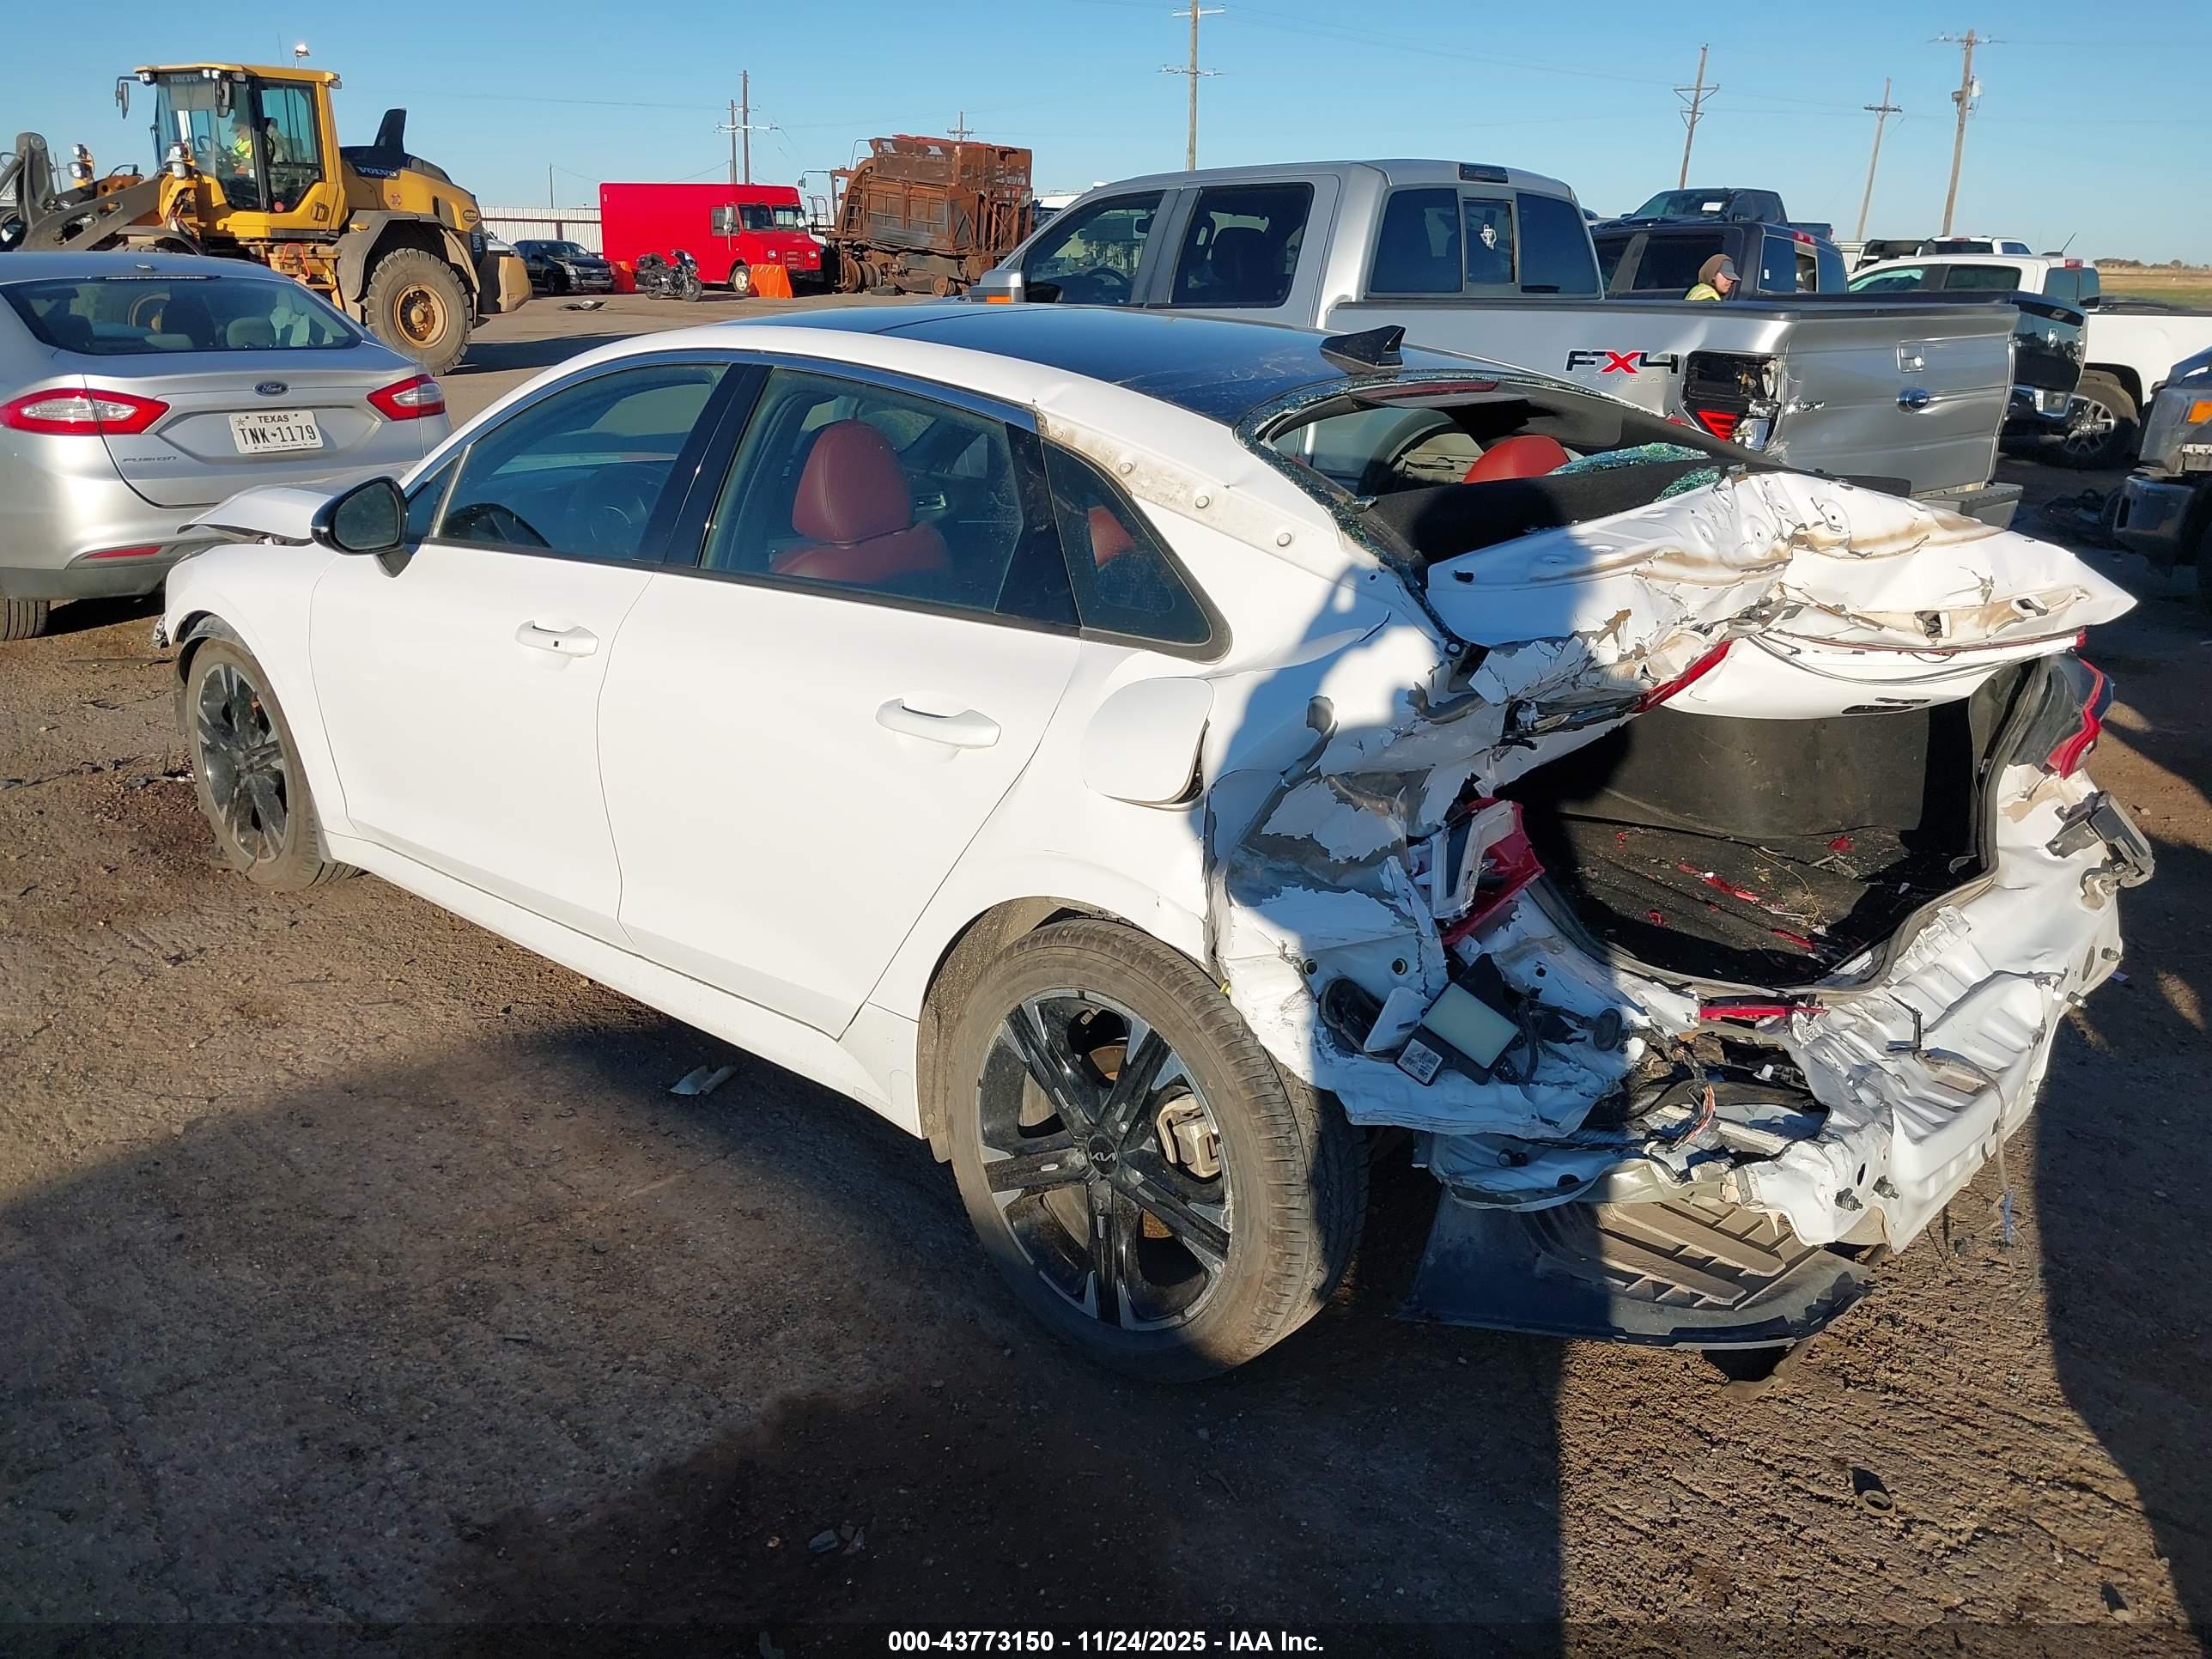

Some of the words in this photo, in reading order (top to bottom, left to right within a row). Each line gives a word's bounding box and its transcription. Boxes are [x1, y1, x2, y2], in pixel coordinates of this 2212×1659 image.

[356, 167, 398, 177] VOLVO
[1565, 349, 1680, 374] FX4
[257, 415, 289, 423] TEXAS
